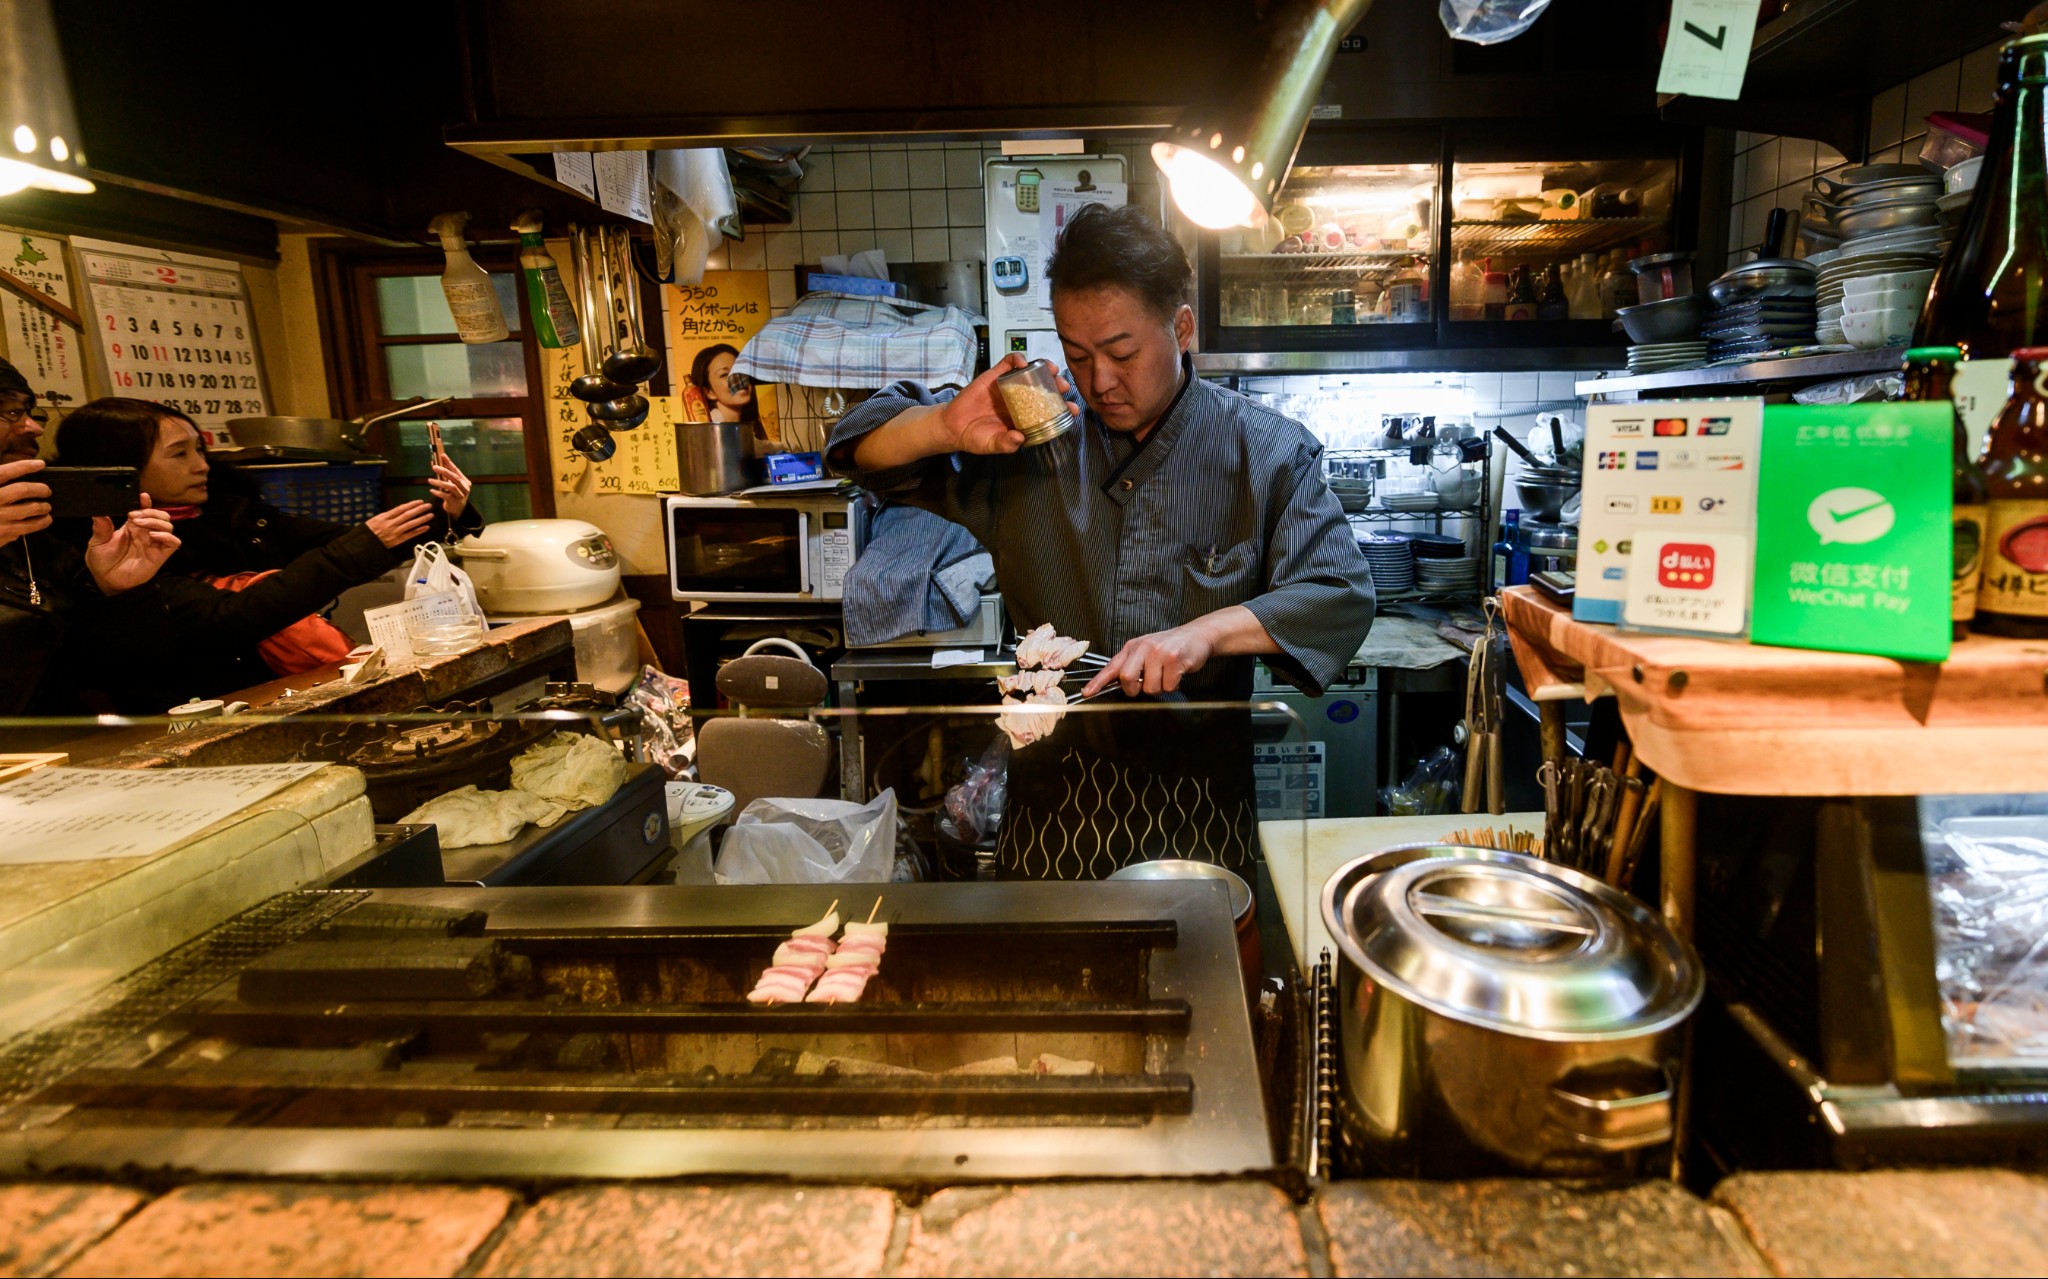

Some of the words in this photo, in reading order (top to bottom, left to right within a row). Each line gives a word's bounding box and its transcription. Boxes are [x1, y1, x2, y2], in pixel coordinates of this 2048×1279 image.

[156, 267, 178, 284] 2
[680, 285, 718, 302] うちの
[230, 302, 238, 315] 1
[680, 301, 759, 317] ハイボールは
[106, 315, 116, 331] 2
[128, 317, 139, 333] 3
[150, 319, 160, 335] 4
[173, 321, 183, 336] 5
[194, 323, 203, 338] 6
[214, 325, 222, 339] 7
[234, 326, 245, 340] 8
[681, 317, 745, 335] 角だから。
[112, 344, 122, 359] 9
[130, 344, 149, 361] 10
[152, 346, 169, 362] 11
[173, 348, 192, 363] 12
[194, 348, 212, 364] 13
[215, 349, 233, 364] 14
[236, 351, 252, 365] 15
[114, 371, 133, 387] 16
[136, 372, 153, 388] 17
[158, 372, 175, 388] 18
[179, 373, 196, 388] 19
[200, 374, 218, 389] 20
[221, 375, 237, 389] 21
[240, 375, 257, 389] 22
[184, 400, 201, 414] 26
[204, 400, 220, 414] 27
[225, 400, 243, 414] 28
[245, 400, 261, 414] 29
[1615, 425, 1642, 433] VISA
[1662, 551, 1711, 570] d払い
[1789, 561, 1911, 591] 微信支付
[1787, 587, 1866, 608] WeChat
[1873, 591, 1912, 615] Pay
